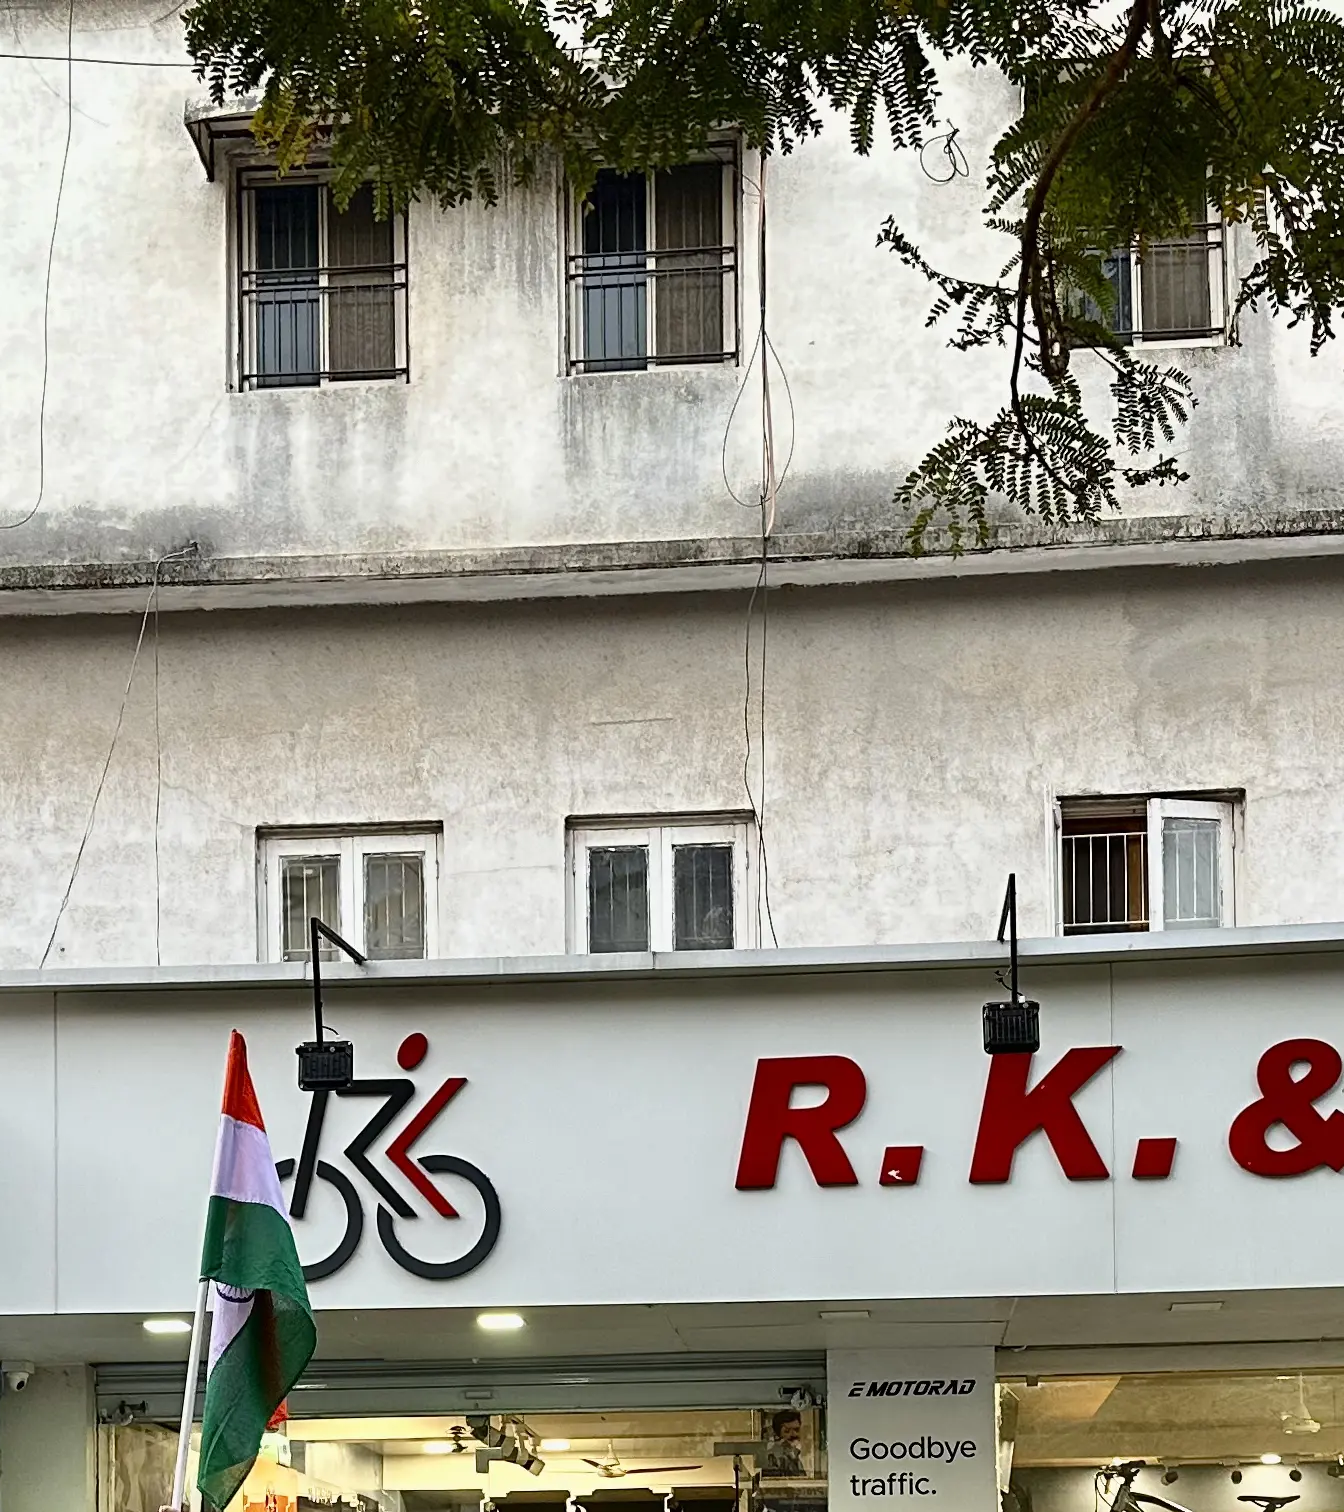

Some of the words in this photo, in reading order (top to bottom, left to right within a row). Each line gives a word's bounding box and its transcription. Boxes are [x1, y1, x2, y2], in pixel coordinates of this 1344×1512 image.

[734, 1054, 924, 1191] R.
[968, 1045, 1180, 1185] K.
[866, 1379, 977, 1397] MOTORAD
[849, 1436, 977, 1466] Goodbye
[850, 1472, 938, 1497] traffic.
